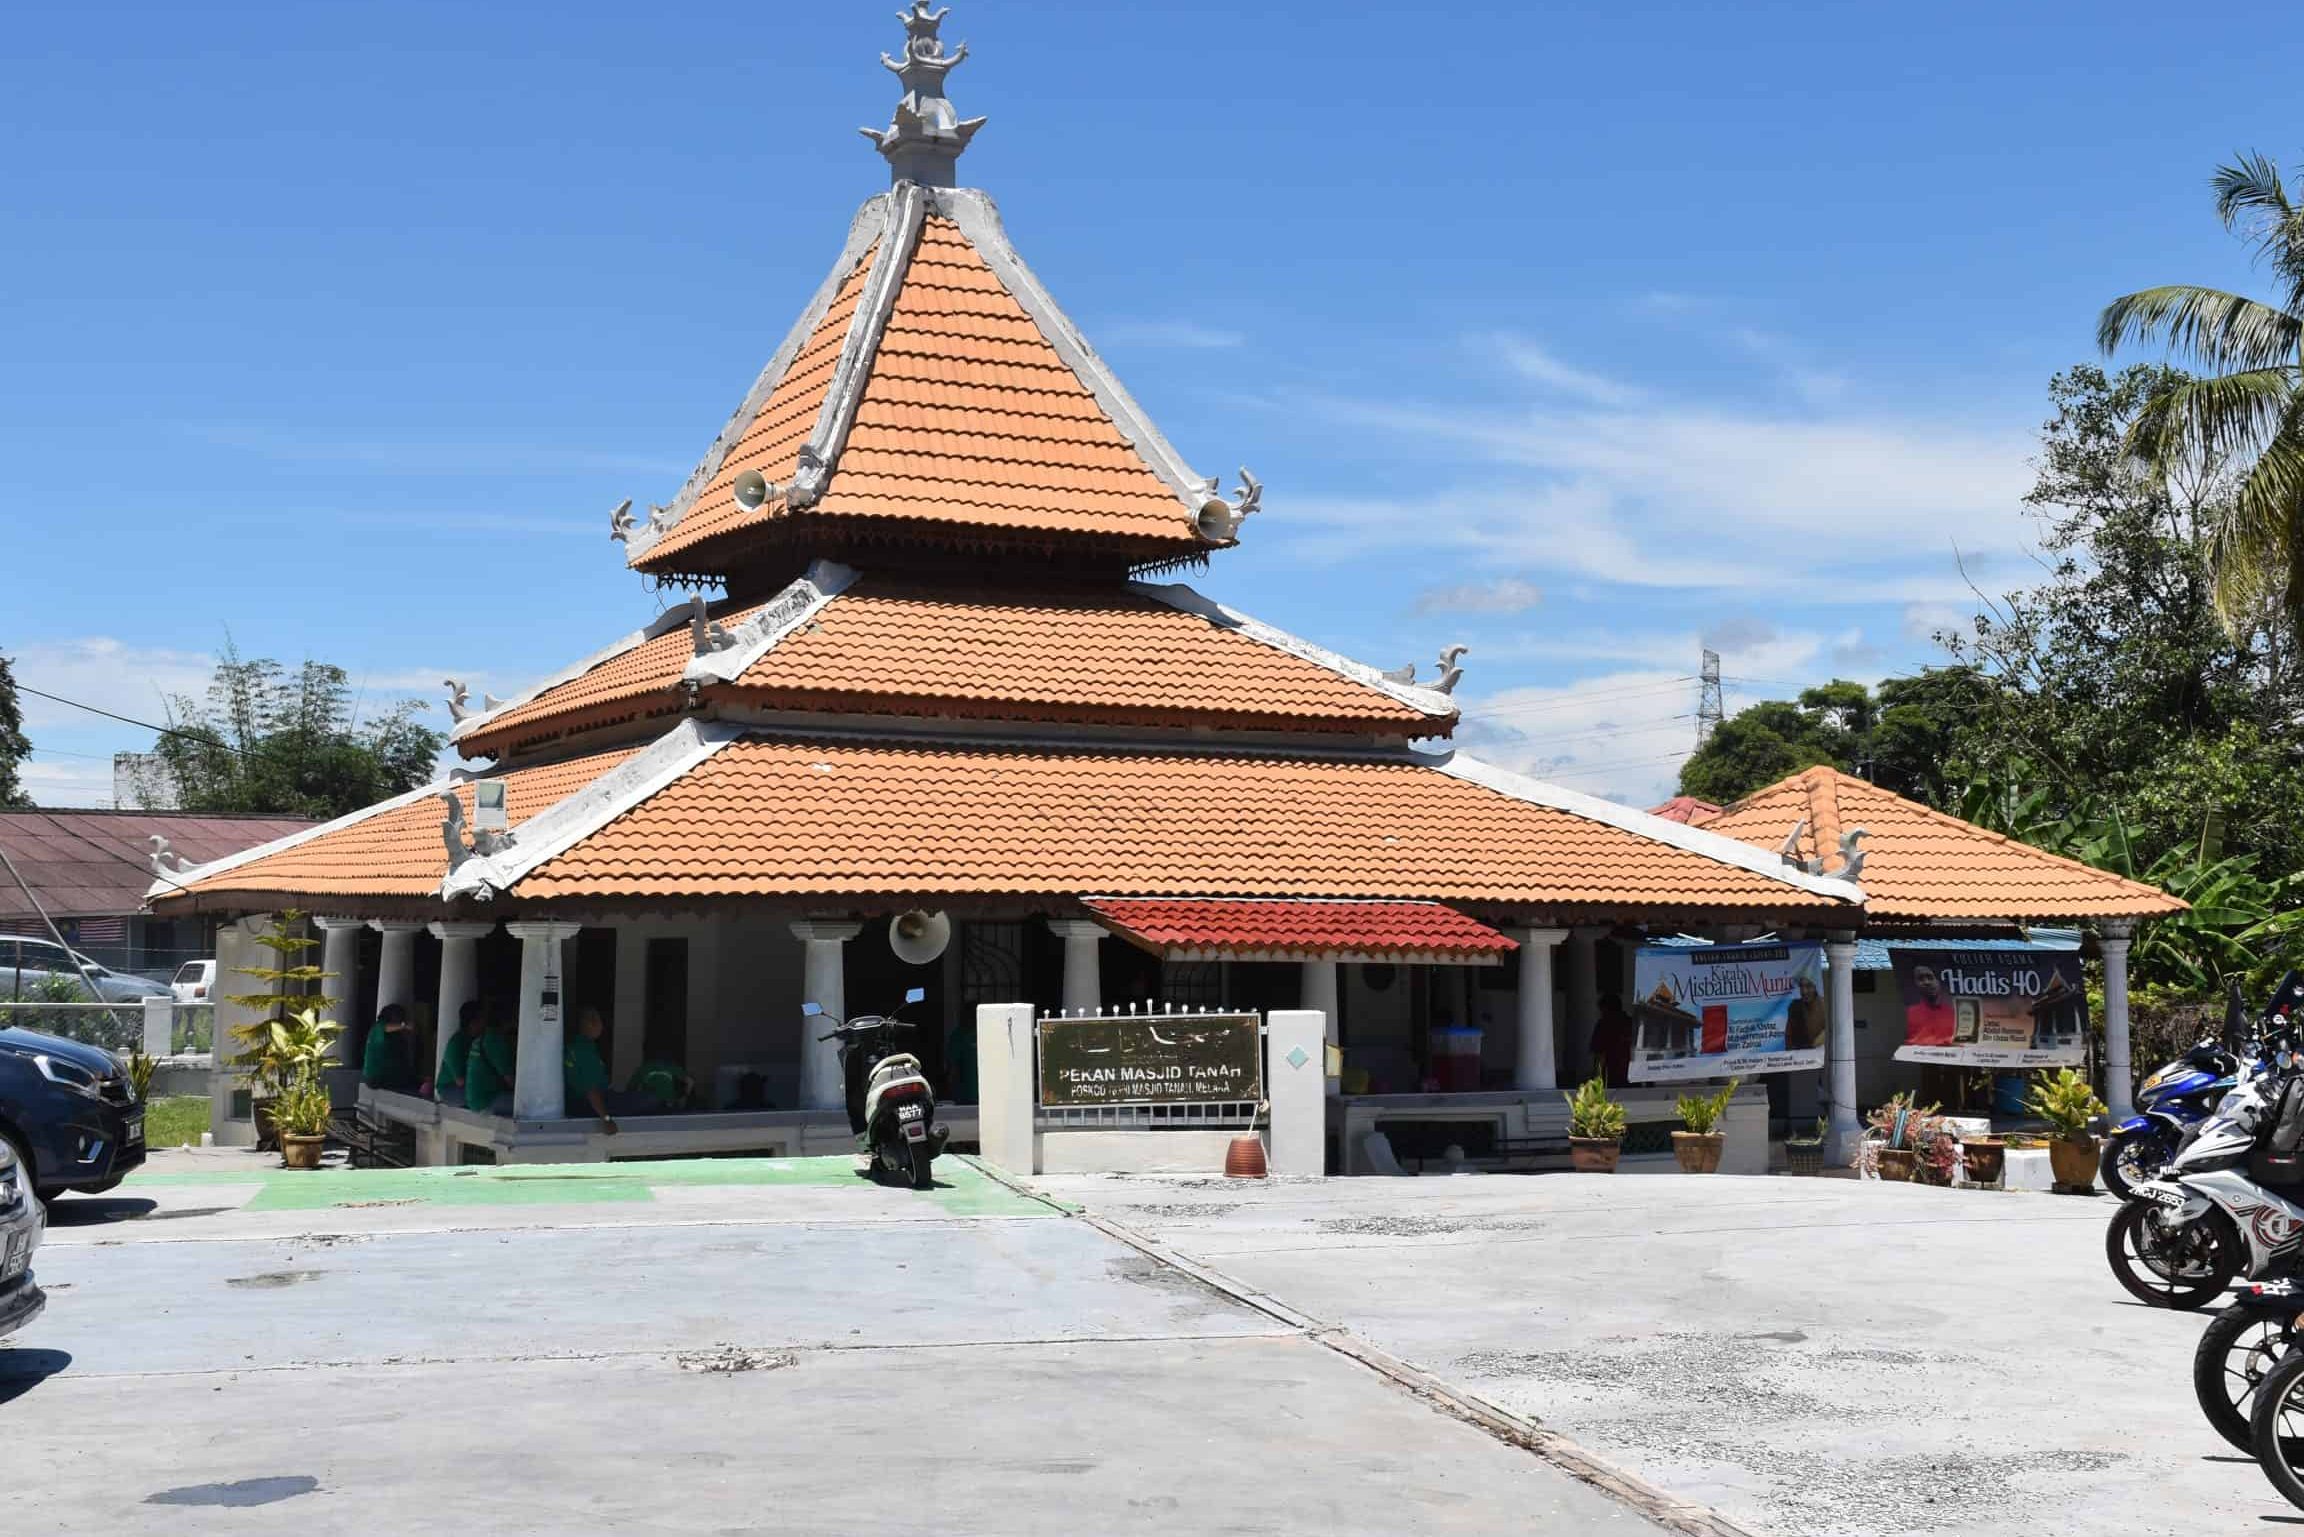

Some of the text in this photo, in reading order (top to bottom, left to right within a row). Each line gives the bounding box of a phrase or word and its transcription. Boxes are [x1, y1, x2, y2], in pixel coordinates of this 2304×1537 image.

[1711, 963, 1745, 981] Kitab
[1940, 968, 2040, 996] Hadis 40
[1672, 972, 1748, 1004] Misbahul
[1121, 1066, 1181, 1081] MASJID
[1189, 1064, 1241, 1078] TANAH
